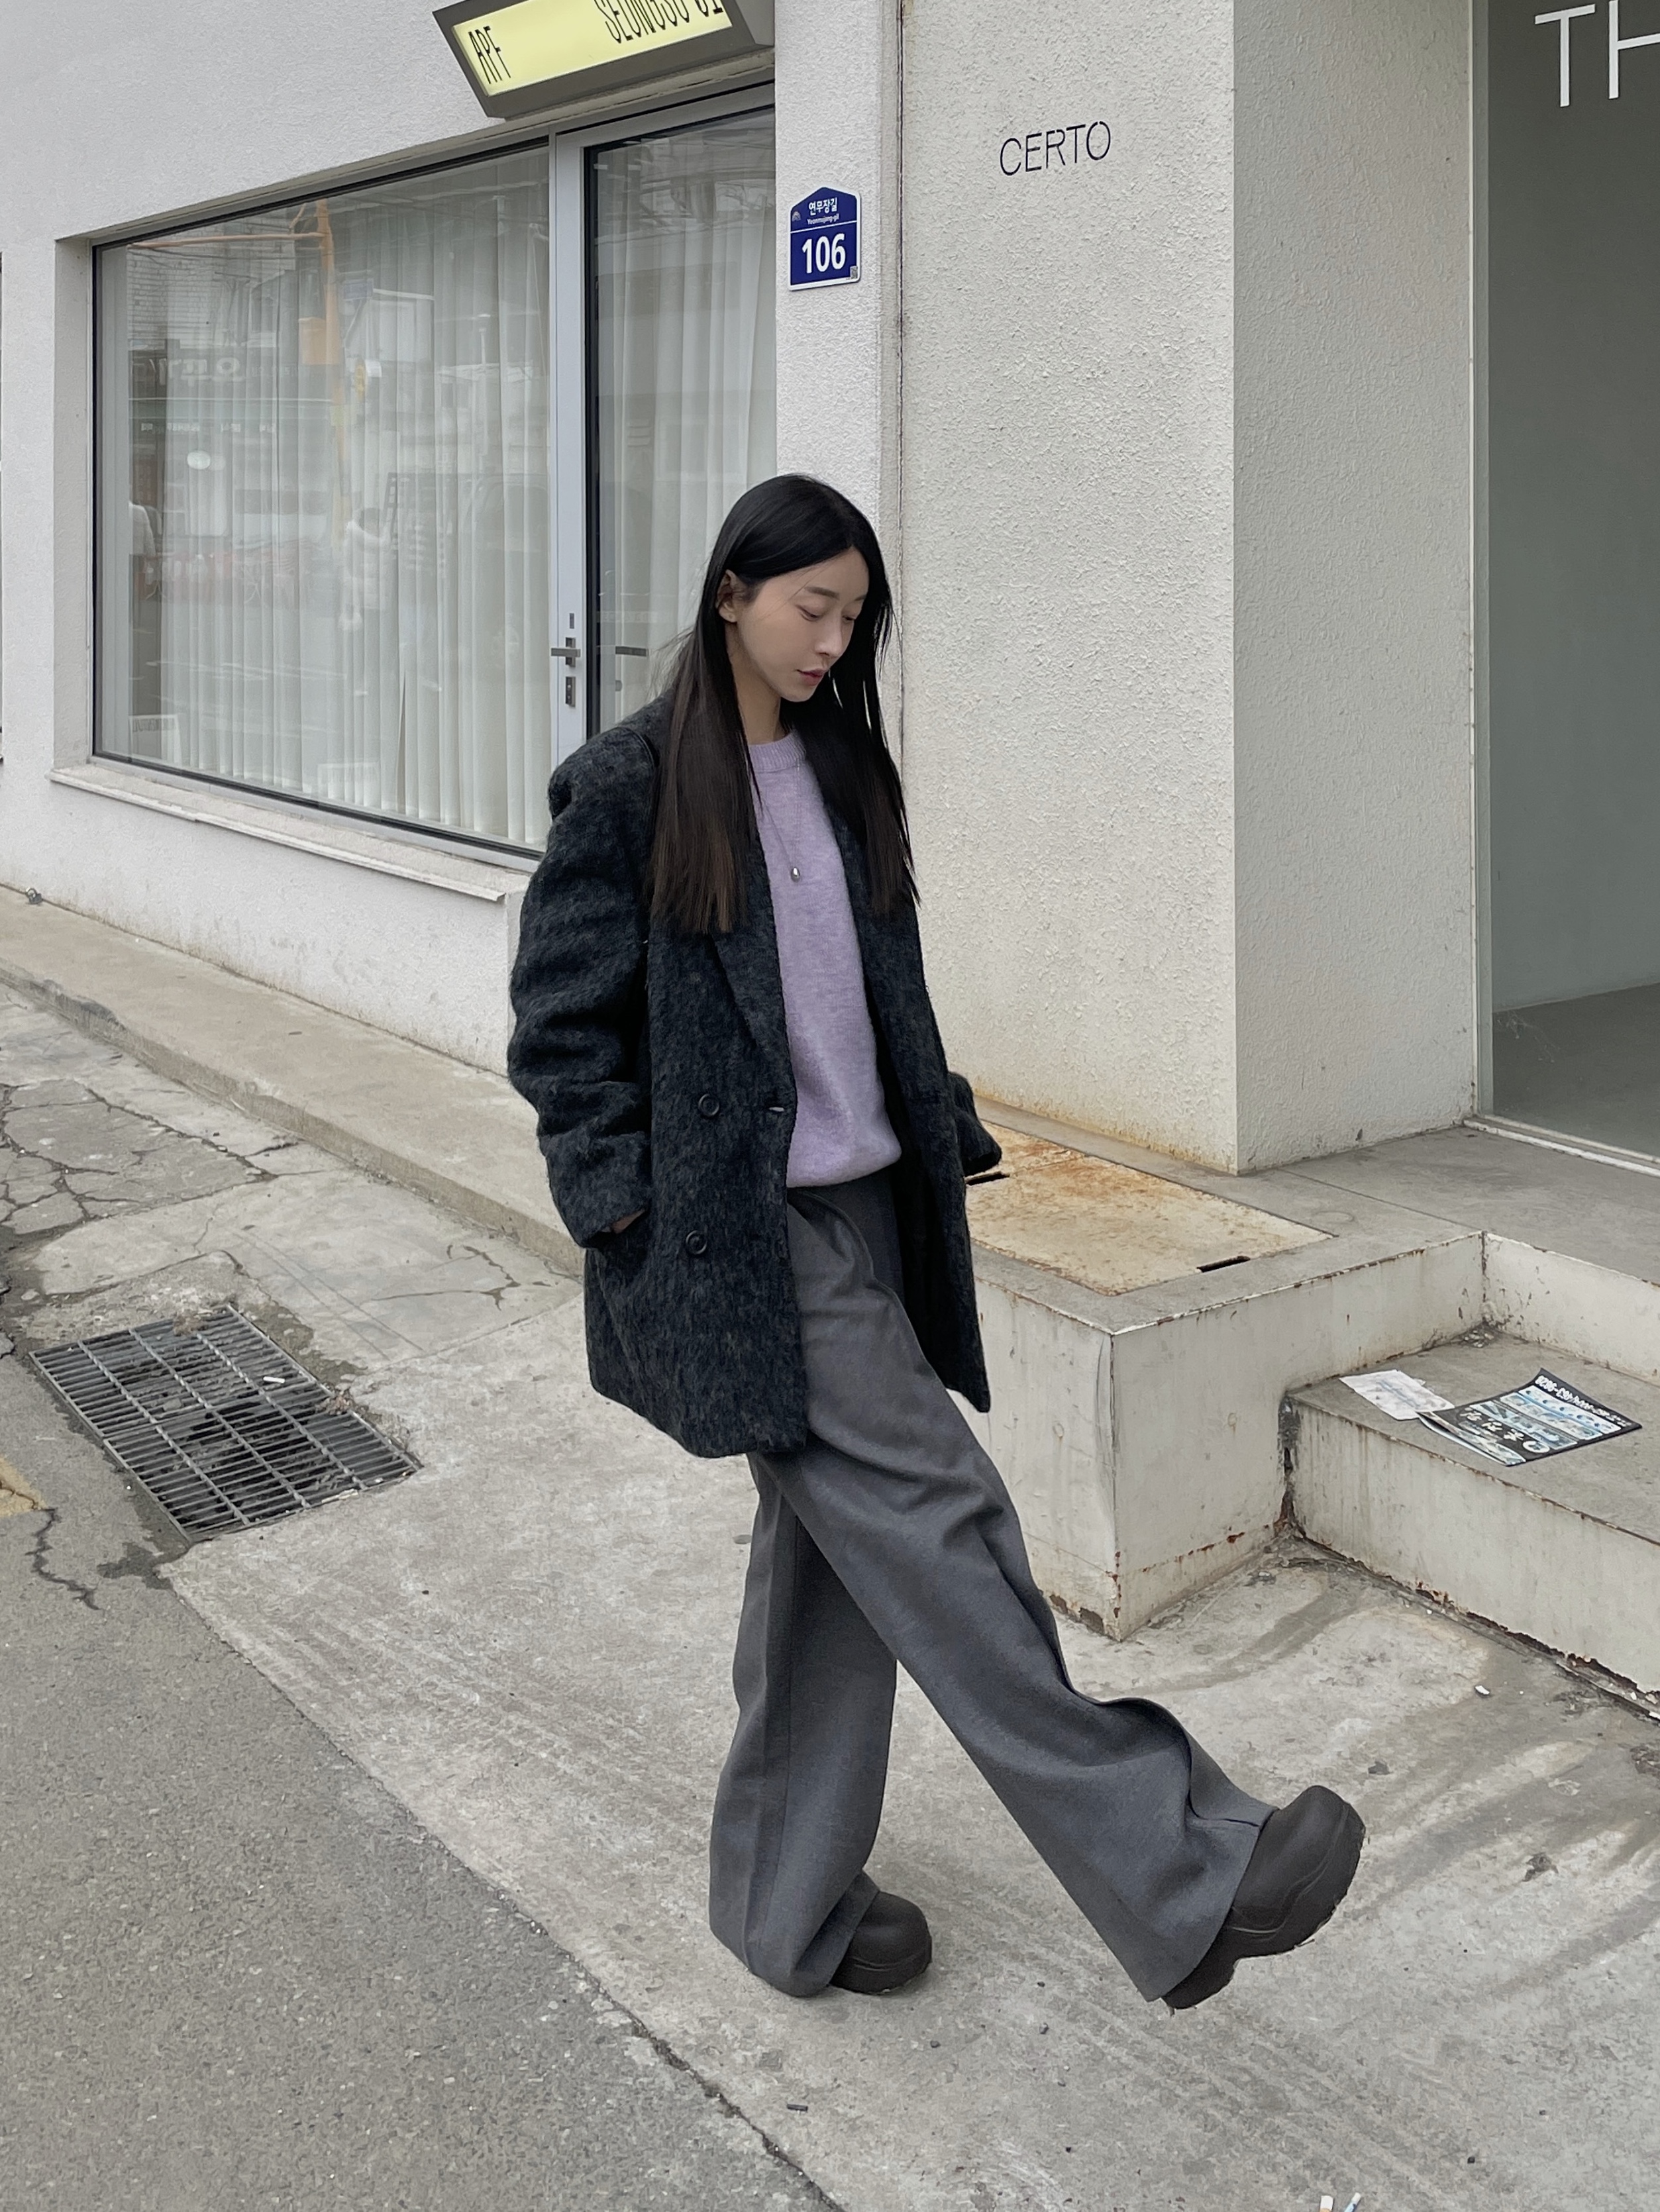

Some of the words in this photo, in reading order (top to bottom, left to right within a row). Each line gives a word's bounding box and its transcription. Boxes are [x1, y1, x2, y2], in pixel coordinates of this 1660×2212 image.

[468, 26, 511, 84] APF
[1000, 121, 1111, 176] CERTO
[809, 197, 838, 215] 연무장길
[802, 233, 846, 274] 106
